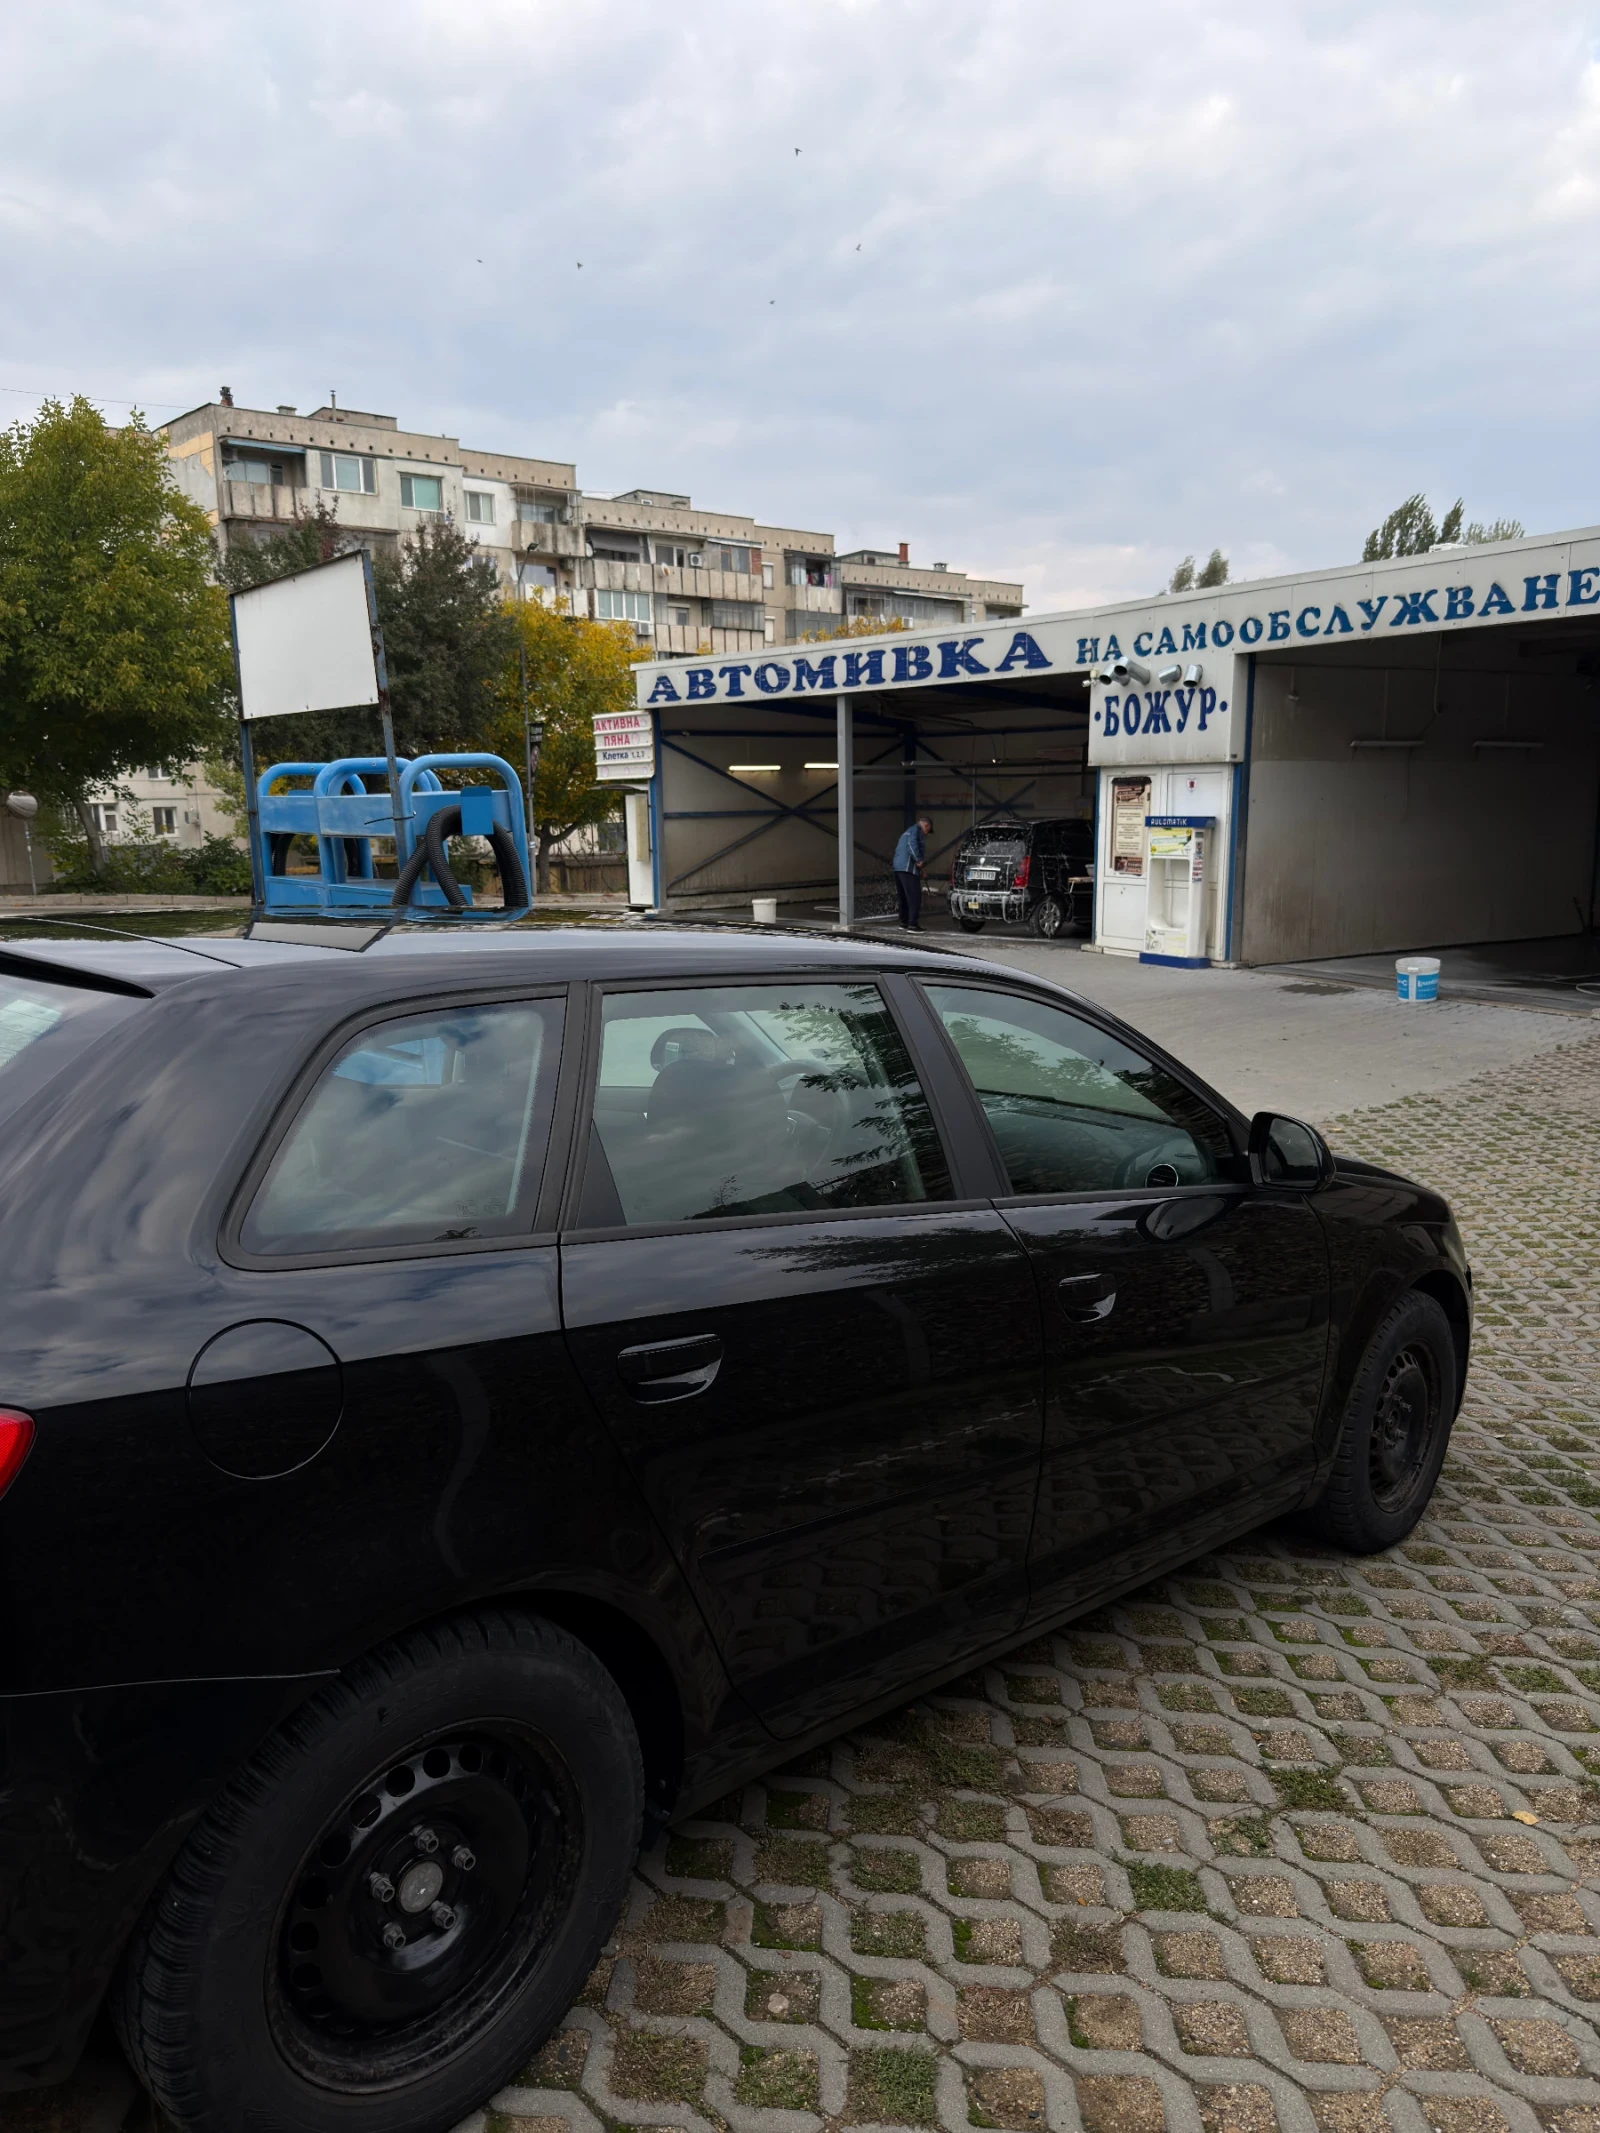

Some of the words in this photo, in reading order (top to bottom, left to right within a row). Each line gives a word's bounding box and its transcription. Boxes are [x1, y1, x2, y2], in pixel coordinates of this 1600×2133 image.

[646, 632, 1053, 703] АВТОМИВКА
[1075, 634, 1124, 665] НА
[1133, 567, 1600, 658] САМООБСЛУЖВАНЕ
[594, 716, 640, 732] АКТИВНА
[603, 734, 630, 747] ПЯНА
[602, 751, 629, 760] Клетка
